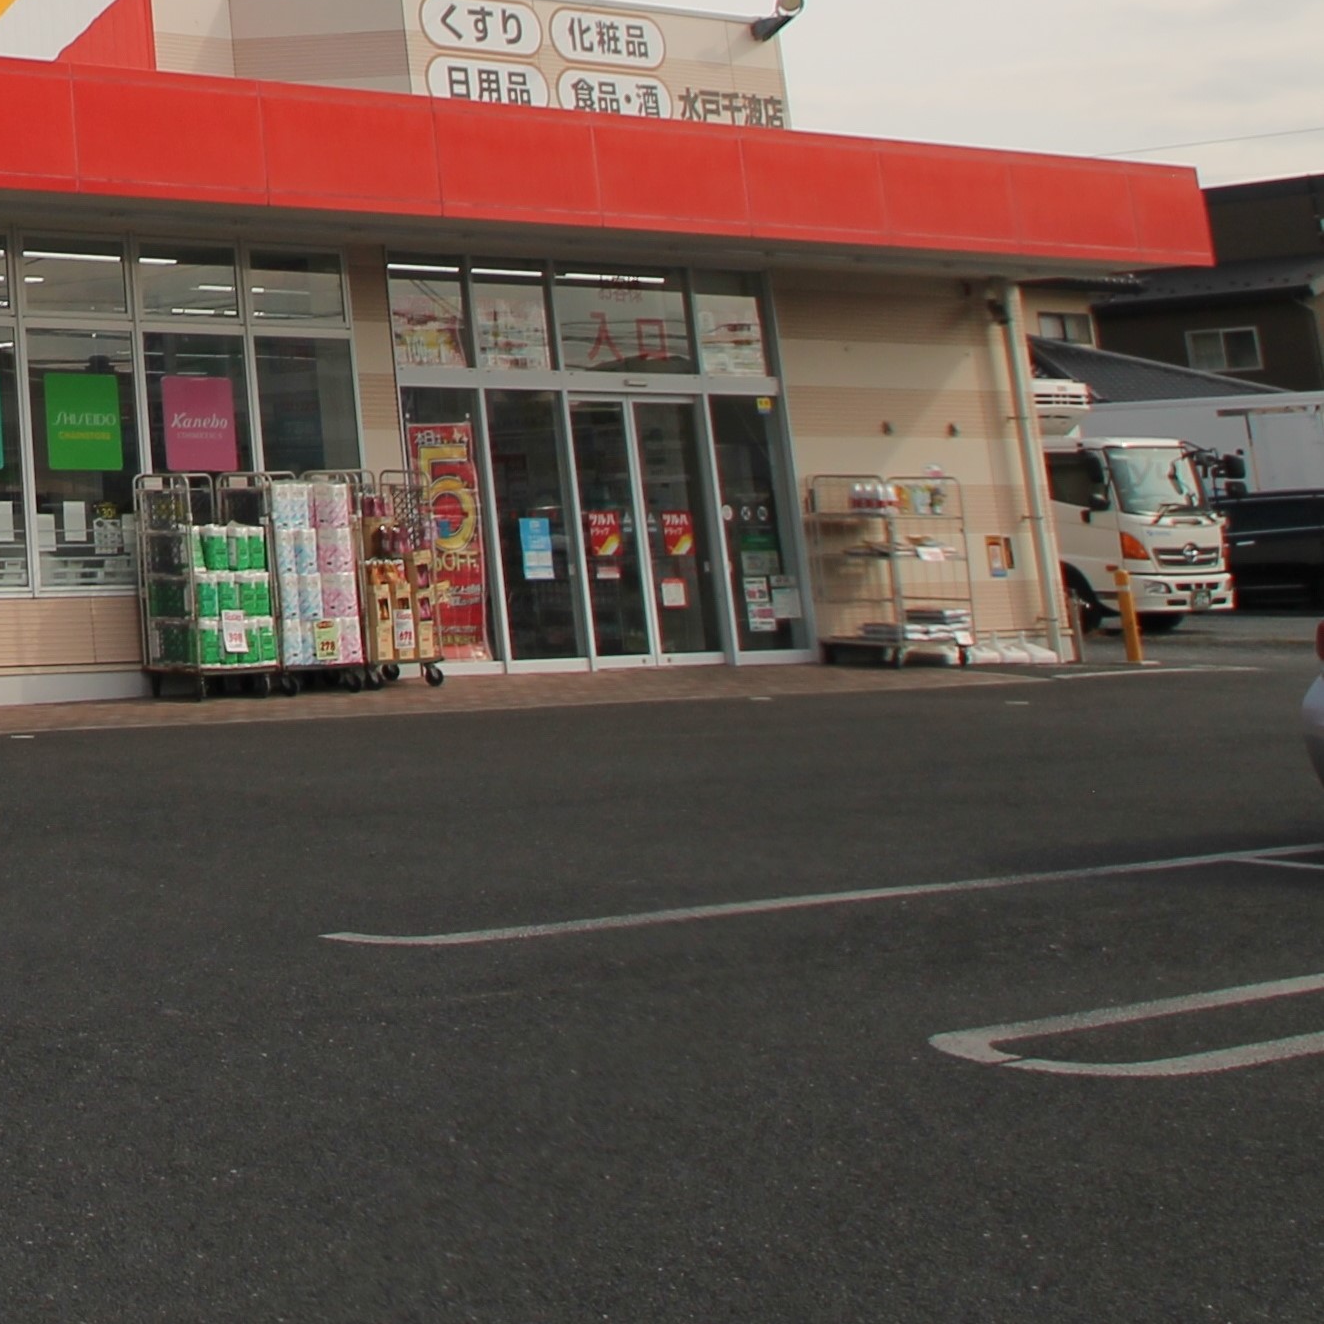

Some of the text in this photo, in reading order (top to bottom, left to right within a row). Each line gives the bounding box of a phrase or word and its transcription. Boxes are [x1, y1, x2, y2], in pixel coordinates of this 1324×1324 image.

[440, 3, 522, 44] くすり
[567, 17, 649, 59] 化粧品
[448, 66, 532, 107] 日用品
[571, 77, 661, 119] 食品・酒
[588, 311, 668, 362] 入口
[53, 411, 117, 426] SHISEIDO
[171, 412, 229, 430] Kanebo
[589, 513, 616, 525] ツルハ
[662, 513, 689, 525] ツルハ
[591, 527, 610, 535] ドラッグ
[664, 527, 683, 535] ドラッグ
